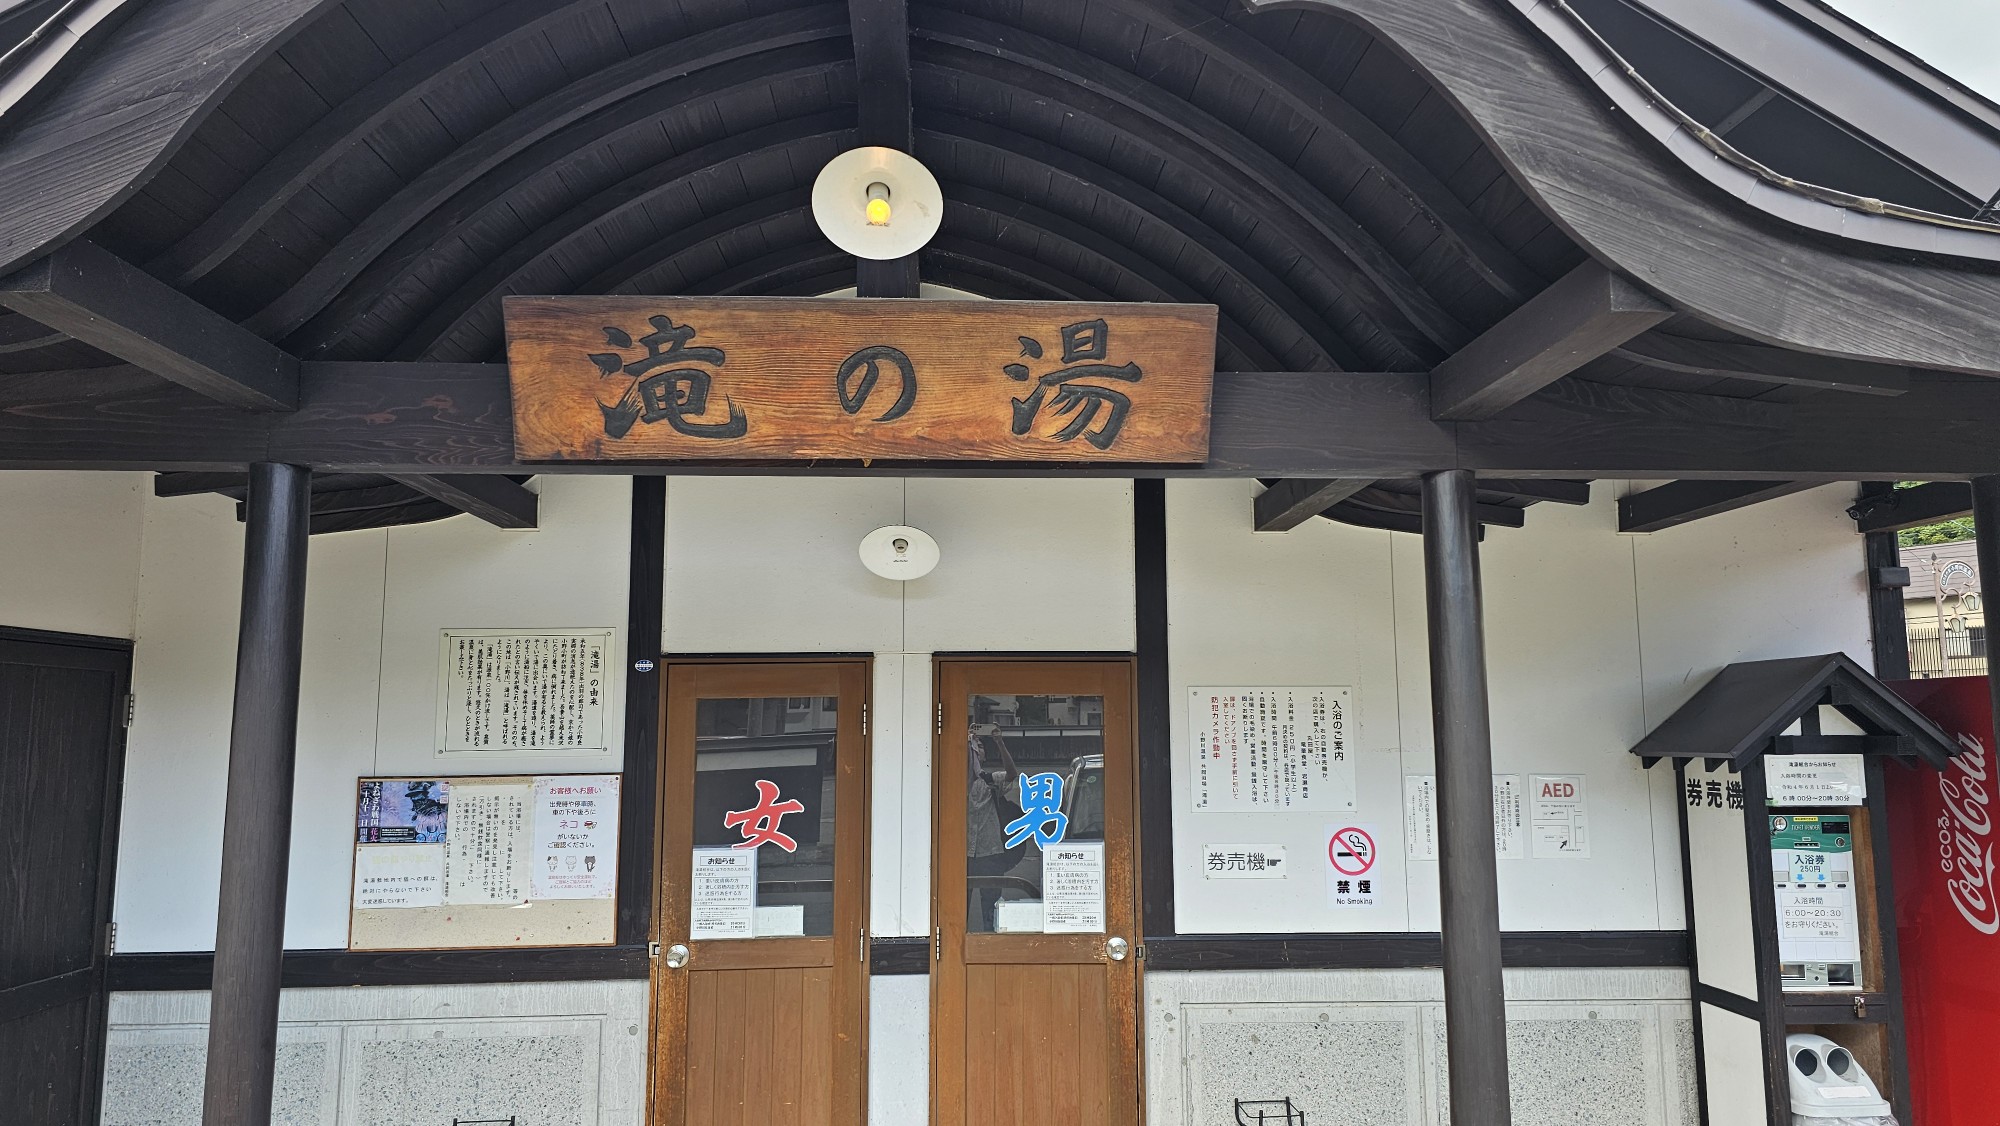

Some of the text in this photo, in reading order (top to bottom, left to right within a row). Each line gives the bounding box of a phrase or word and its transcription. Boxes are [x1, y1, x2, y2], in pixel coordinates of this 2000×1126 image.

[587, 313, 1143, 451] 滝の湯
[1211, 696, 1221, 760] 防犯カメラ作動中
[1332, 700, 1344, 761] 入浴のご案内
[550, 786, 602, 795] お客様へお願い
[1542, 783, 1574, 797] AED
[1687, 778, 1744, 810] 券売機
[724, 780, 804, 853] 女
[1004, 772, 1069, 852] 男
[560, 820, 579, 829] ネコ
[1207, 852, 1265, 871] 券売機
[1795, 855, 1825, 864] 入浴券
[1337, 880, 1372, 894] 禁煙
[1794, 897, 1824, 905] 入浴時間
[1784, 921, 1838, 929] をお守りください。
